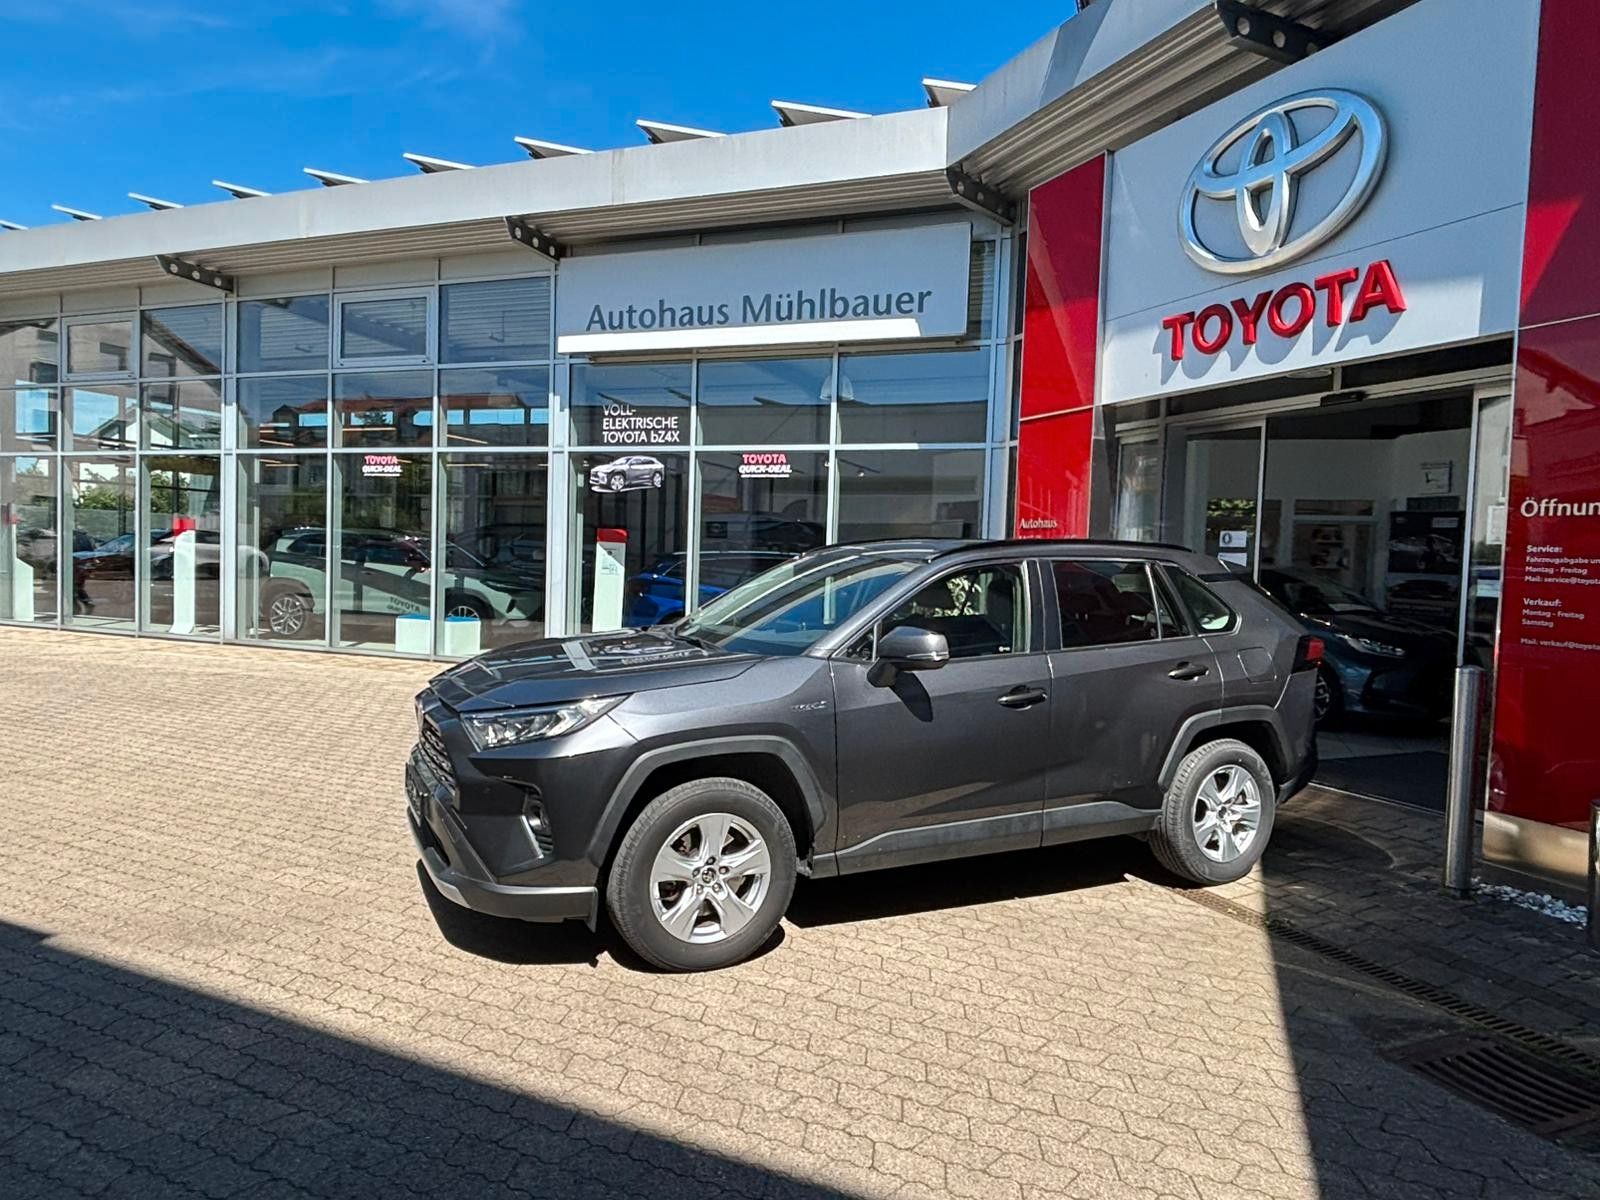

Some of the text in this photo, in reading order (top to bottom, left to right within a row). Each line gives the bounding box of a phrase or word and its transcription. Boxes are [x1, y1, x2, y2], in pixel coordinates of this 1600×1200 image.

[585, 288, 933, 332] Autohaus Mühlbauer
[1162, 259, 1407, 361] TOYOTA
[602, 403, 637, 416] VOLL-
[602, 416, 679, 430] ELEKTRISCHE
[602, 429, 680, 444] TOYOTA bZ4X
[364, 455, 398, 465] TOYOTA
[742, 453, 787, 464] TOYOTA
[738, 464, 793, 474] QUICK-DEAL
[1520, 496, 1600, 518] Öffnun
[1020, 517, 1058, 529] Autohaus
[1526, 545, 1563, 553] Service:
[1525, 566, 1554, 574] Montag
[1560, 567, 1588, 575] Freitag
[1523, 598, 1562, 607] Verkauf:
[1522, 609, 1551, 618] Montag
[1557, 611, 1585, 620] Freitag
